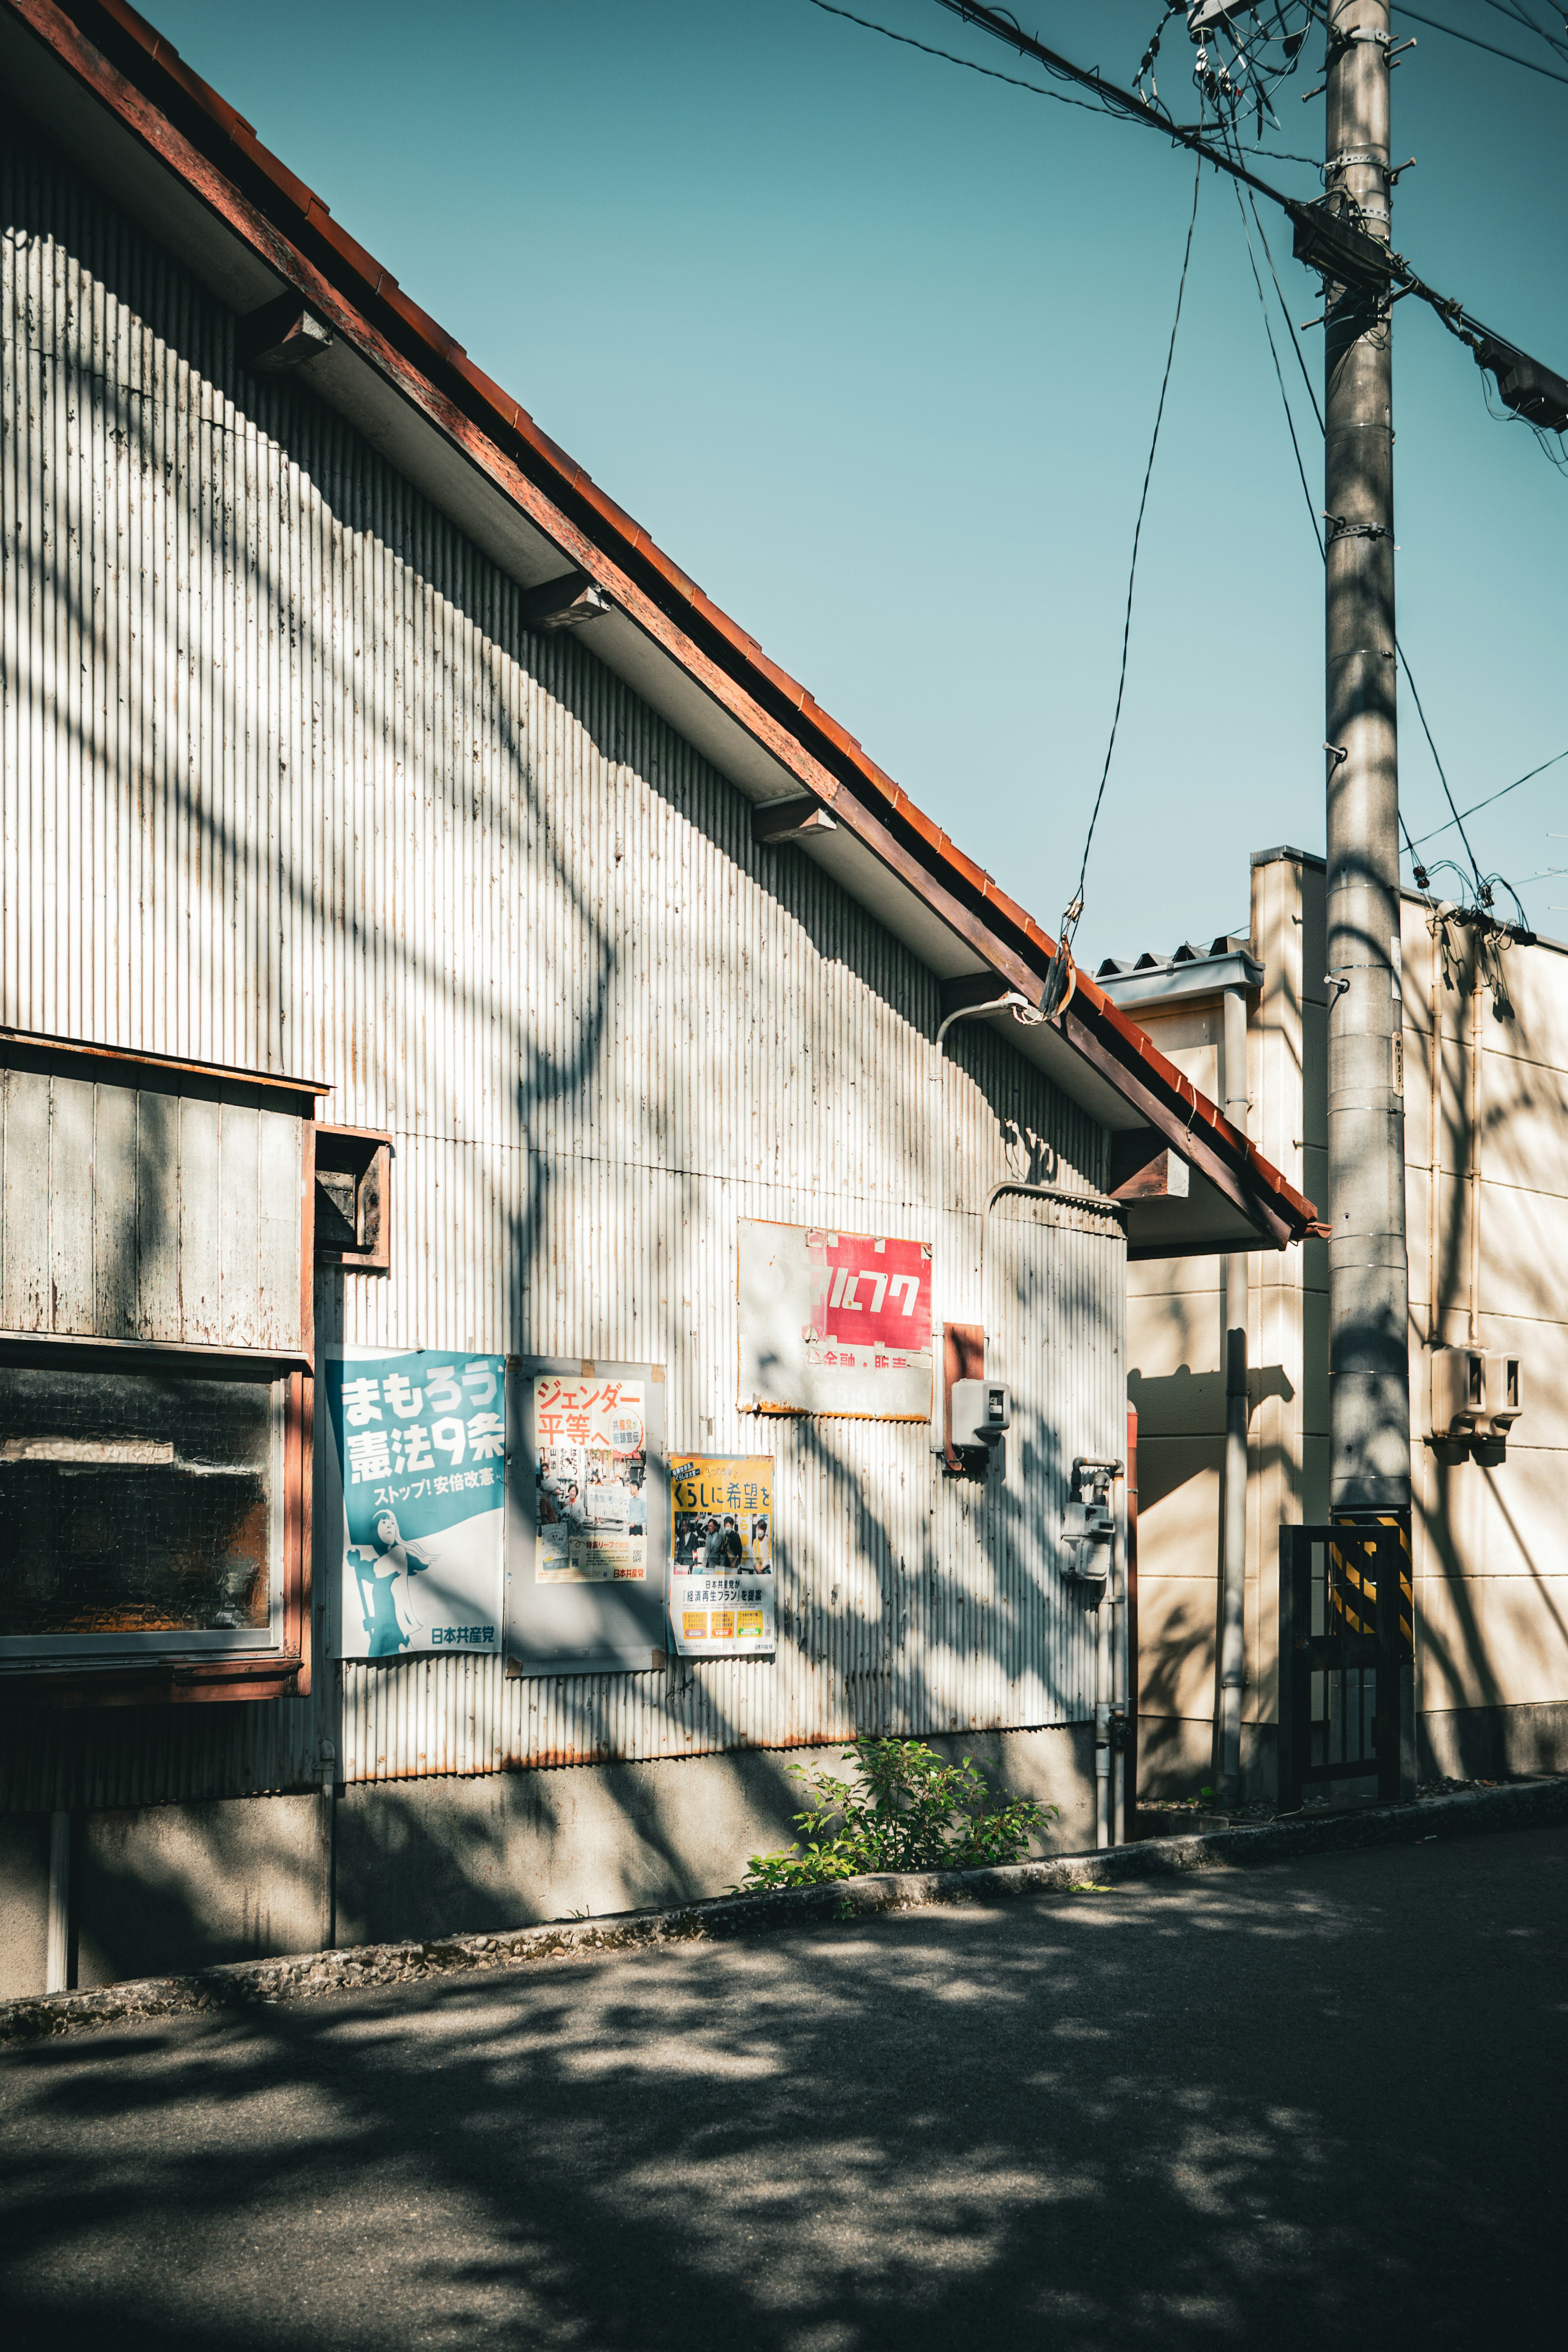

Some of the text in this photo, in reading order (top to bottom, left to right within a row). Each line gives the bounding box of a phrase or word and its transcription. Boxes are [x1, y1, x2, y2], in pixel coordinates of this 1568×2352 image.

[538, 1380, 640, 1413] ジェンダー
[539, 1414, 610, 1446] 平等へ
[613, 1419, 637, 1431] 共産党が
[613, 1432, 639, 1444] 街頭宣伝
[347, 1412, 505, 1484] 憲法9条
[675, 1482, 770, 1509] くらしに希望を
[613, 1569, 644, 1578] 日本共産党
[706, 1580, 740, 1589] 日本共産党が
[683, 1590, 762, 1602] 「経済再生プラン」を提案
[432, 1626, 494, 1644] 日本共産党
